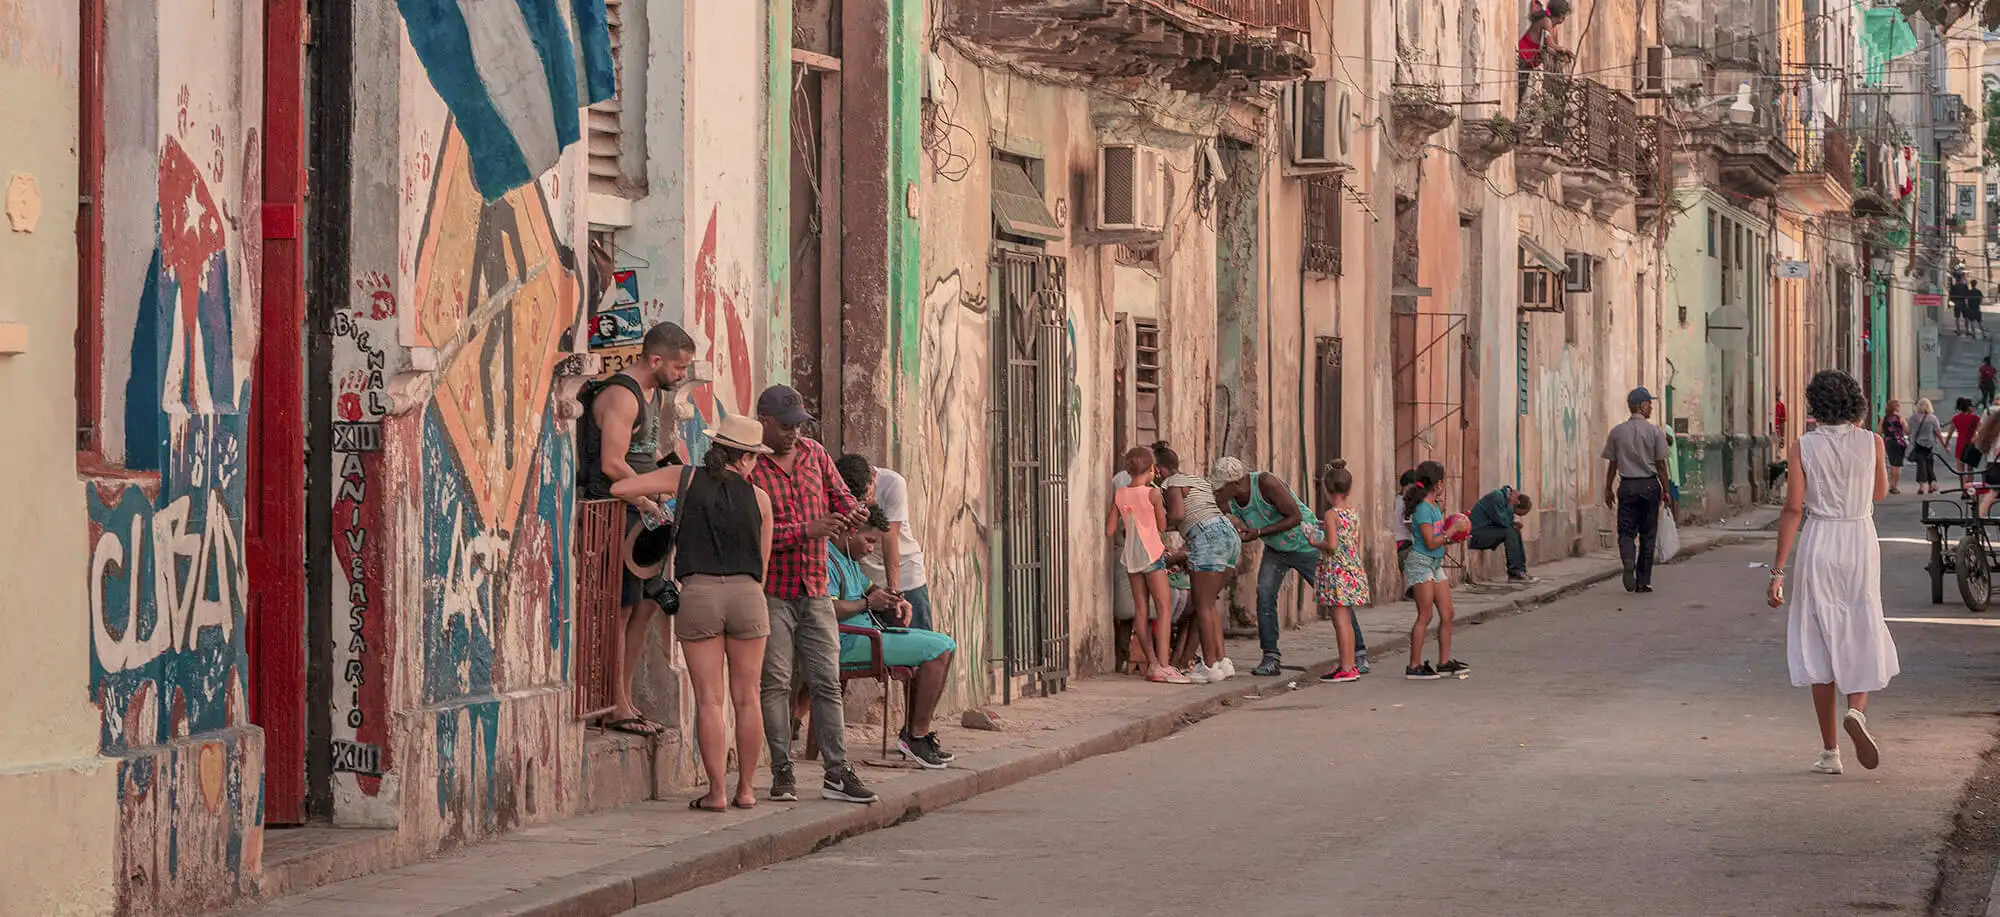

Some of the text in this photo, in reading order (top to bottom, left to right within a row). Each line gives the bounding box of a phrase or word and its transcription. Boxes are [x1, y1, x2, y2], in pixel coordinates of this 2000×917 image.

[333, 421, 383, 452] XIII
[91, 488, 234, 674] CUBA
[331, 740, 383, 775] XIII
